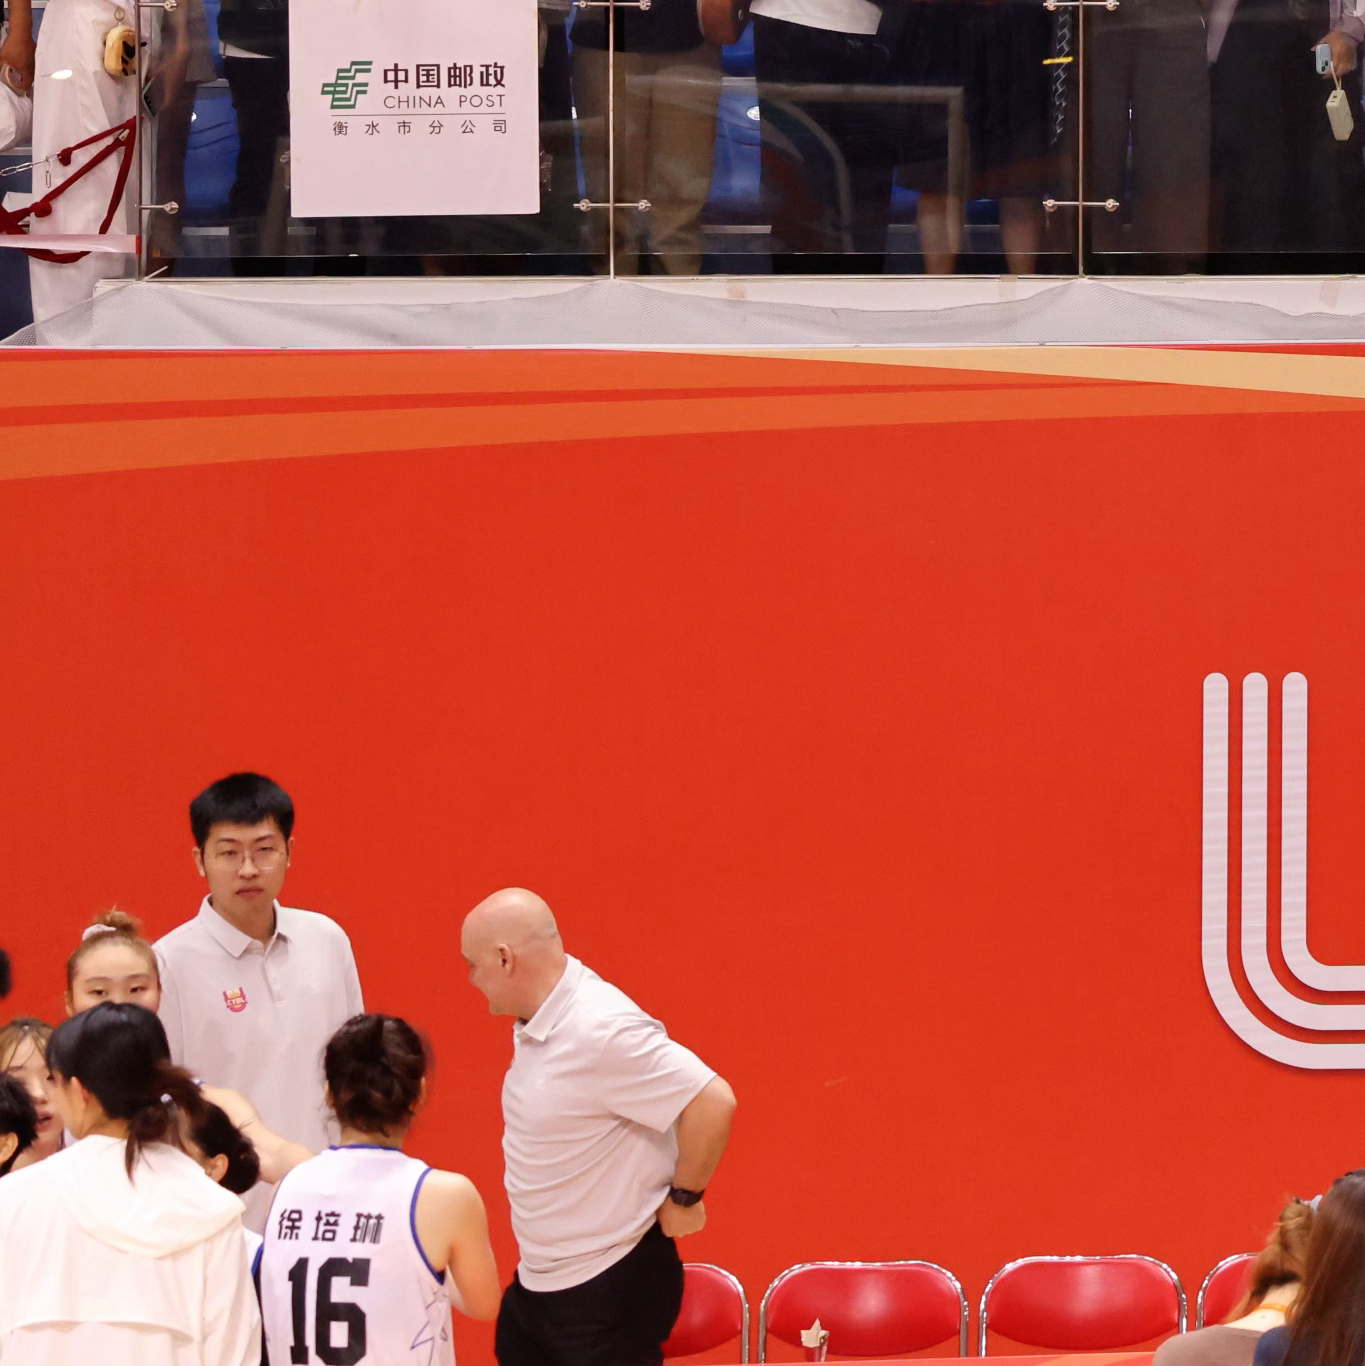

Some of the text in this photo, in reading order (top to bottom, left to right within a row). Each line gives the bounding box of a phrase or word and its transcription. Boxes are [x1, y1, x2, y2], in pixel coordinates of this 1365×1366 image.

[383, 62, 506, 89] 中国邮政
[384, 94, 506, 109] CHINA POST
[332, 119, 507, 136] 衡水市分公司
[288, 1256, 371, 1366] 16
